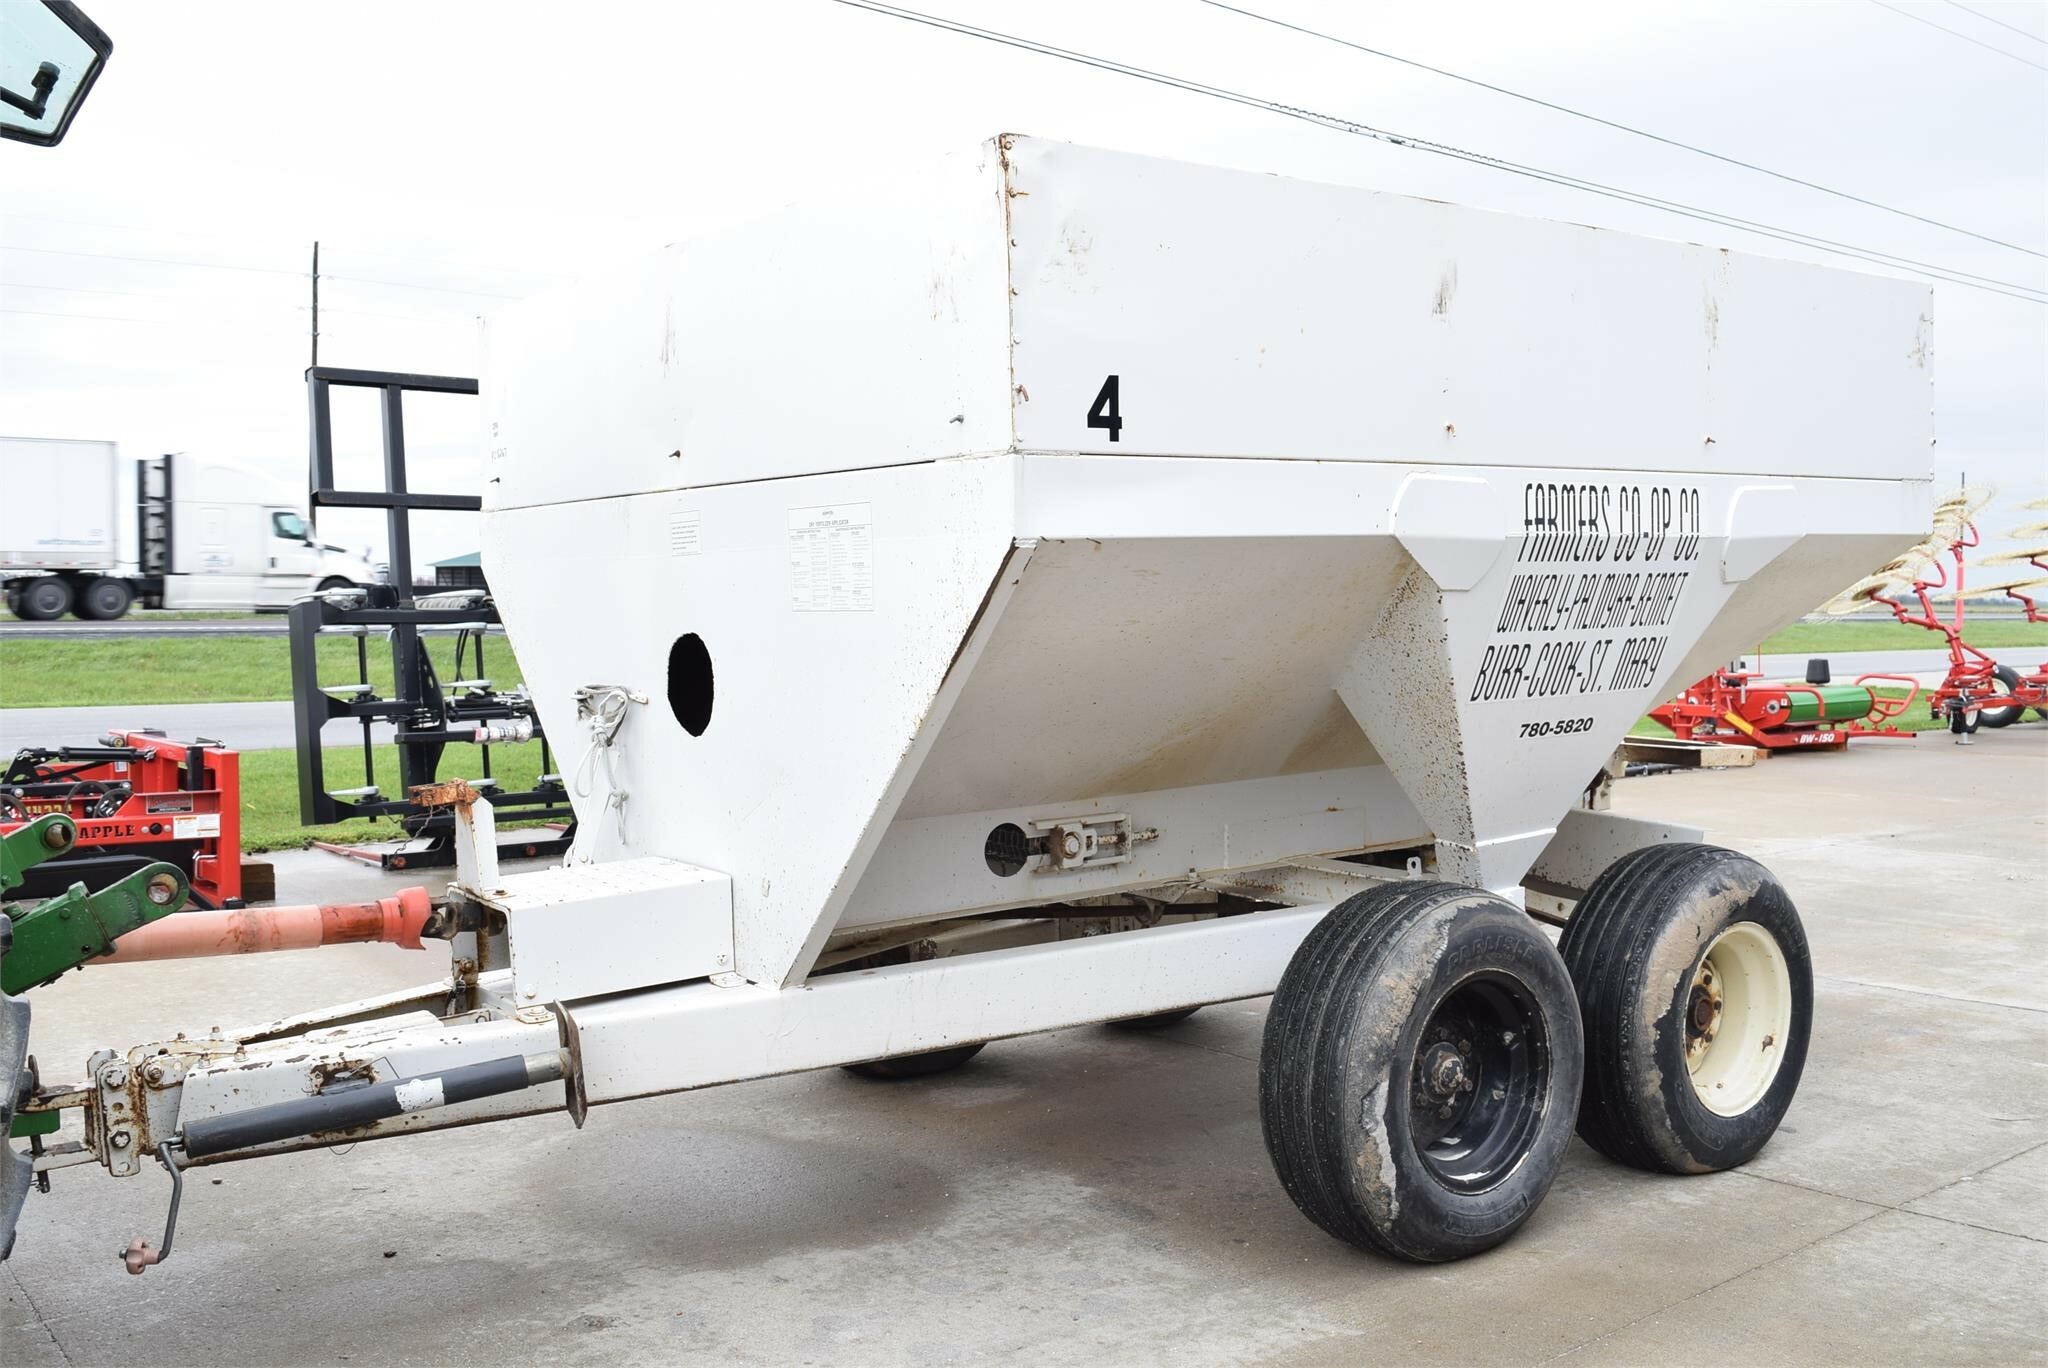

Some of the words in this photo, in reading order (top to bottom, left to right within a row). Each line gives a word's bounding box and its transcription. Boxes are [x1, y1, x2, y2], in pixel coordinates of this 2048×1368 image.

[1087, 375, 1122, 441] 4
[1517, 483, 1610, 562] FARMERS
[1613, 486, 1671, 562] CO-OP
[1673, 488, 1700, 561] CO.
[1608, 636, 1668, 691] MARY
[1519, 717, 1594, 738] 780-5820
[1800, 733, 1835, 744] BW-150
